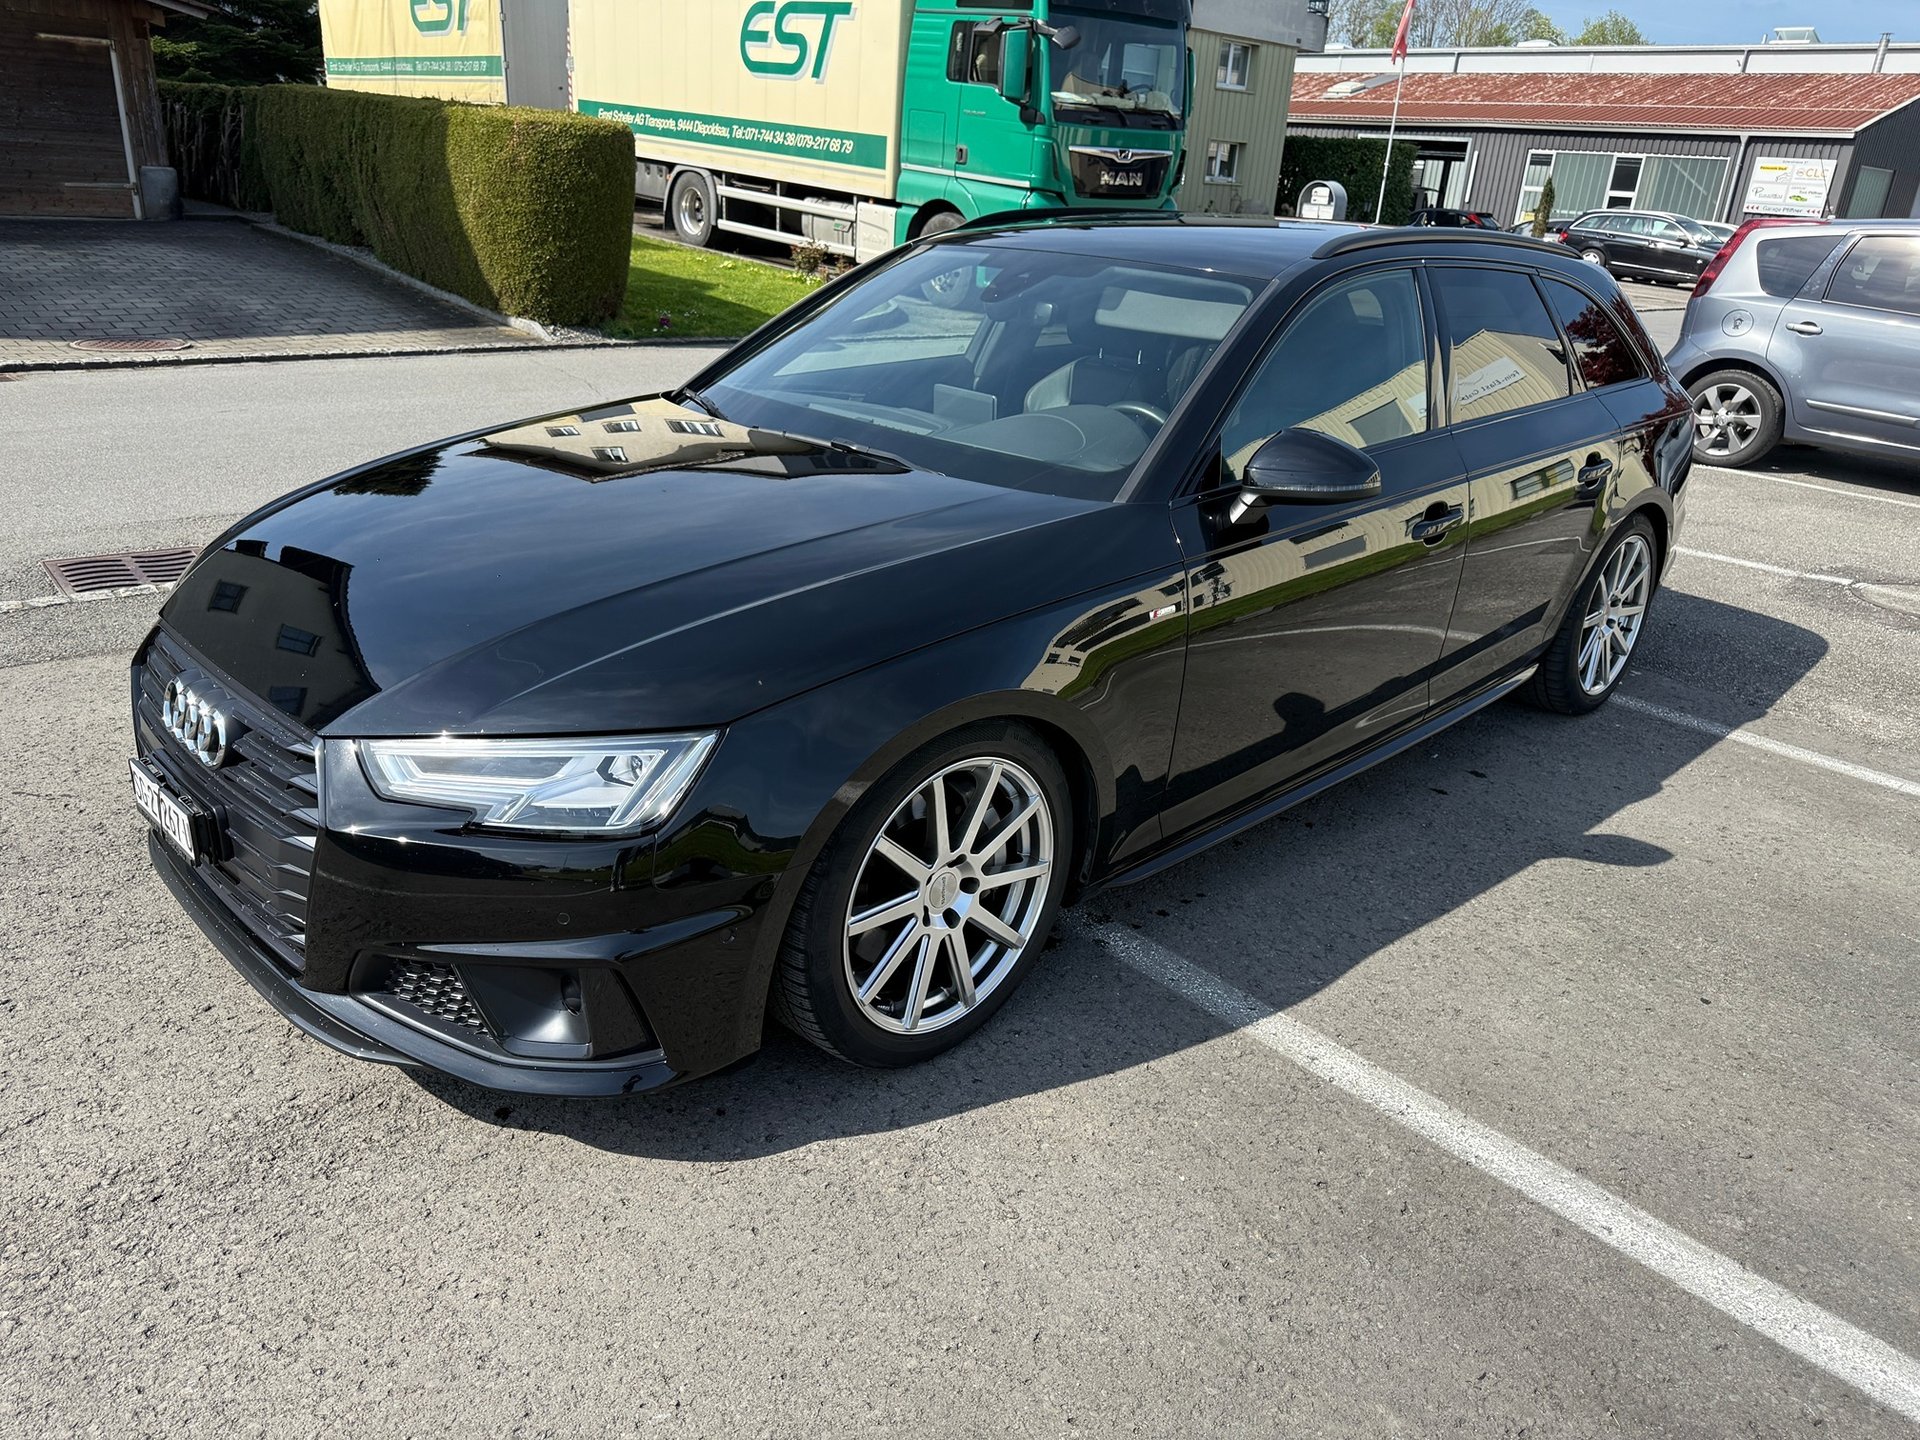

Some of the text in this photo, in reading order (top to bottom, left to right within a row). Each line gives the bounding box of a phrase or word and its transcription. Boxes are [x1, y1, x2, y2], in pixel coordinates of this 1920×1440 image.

[740, 1, 854, 81] EST
[634, 112, 645, 126] AG
[677, 118, 694, 133] 9444
[773, 130, 785, 145] 34
[829, 139, 842, 153] 68
[841, 139, 854, 154] 79
[1100, 170, 1143, 186] MAN
